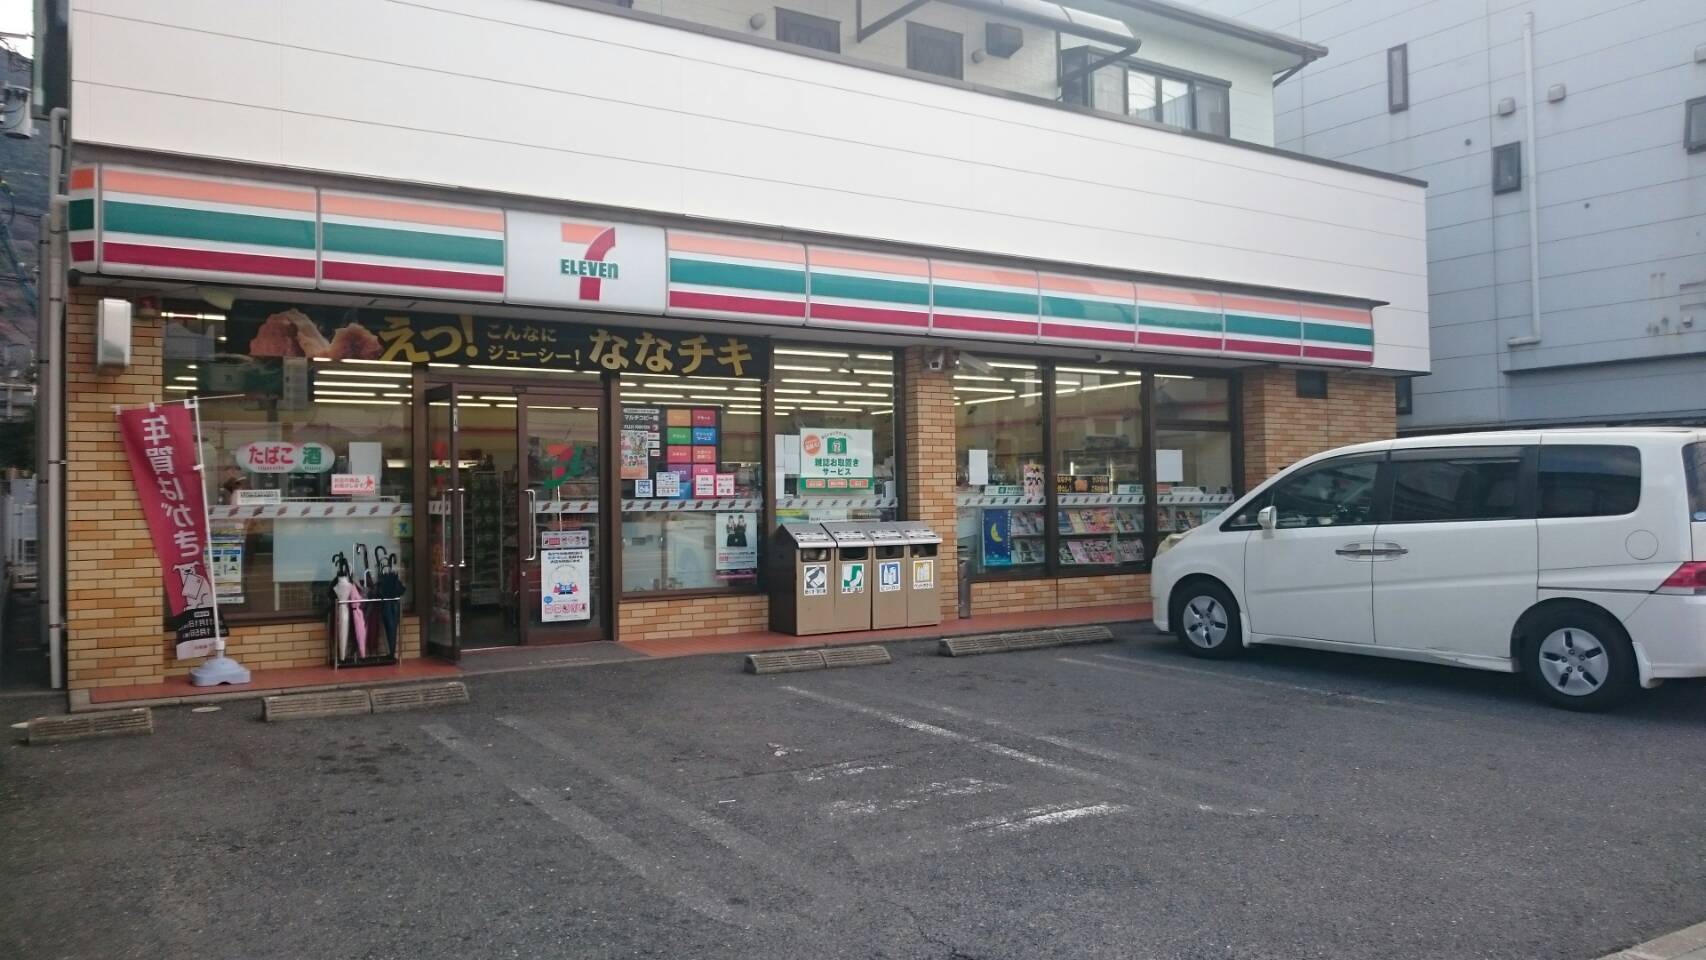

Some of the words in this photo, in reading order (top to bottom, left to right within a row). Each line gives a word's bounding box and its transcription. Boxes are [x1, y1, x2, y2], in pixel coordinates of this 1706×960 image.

[560, 258, 619, 279] ELEVEn
[561, 222, 616, 302] 7
[378, 315, 479, 363] えっ!
[487, 324, 558, 343] こんなに
[487, 344, 580, 366] ジューシー!
[588, 328, 753, 377] ななチキ
[248, 446, 294, 465] たばこ
[302, 446, 322, 465] 酒
[814, 457, 860, 468] 雑誌お取置き
[822, 468, 852, 476] サービス
